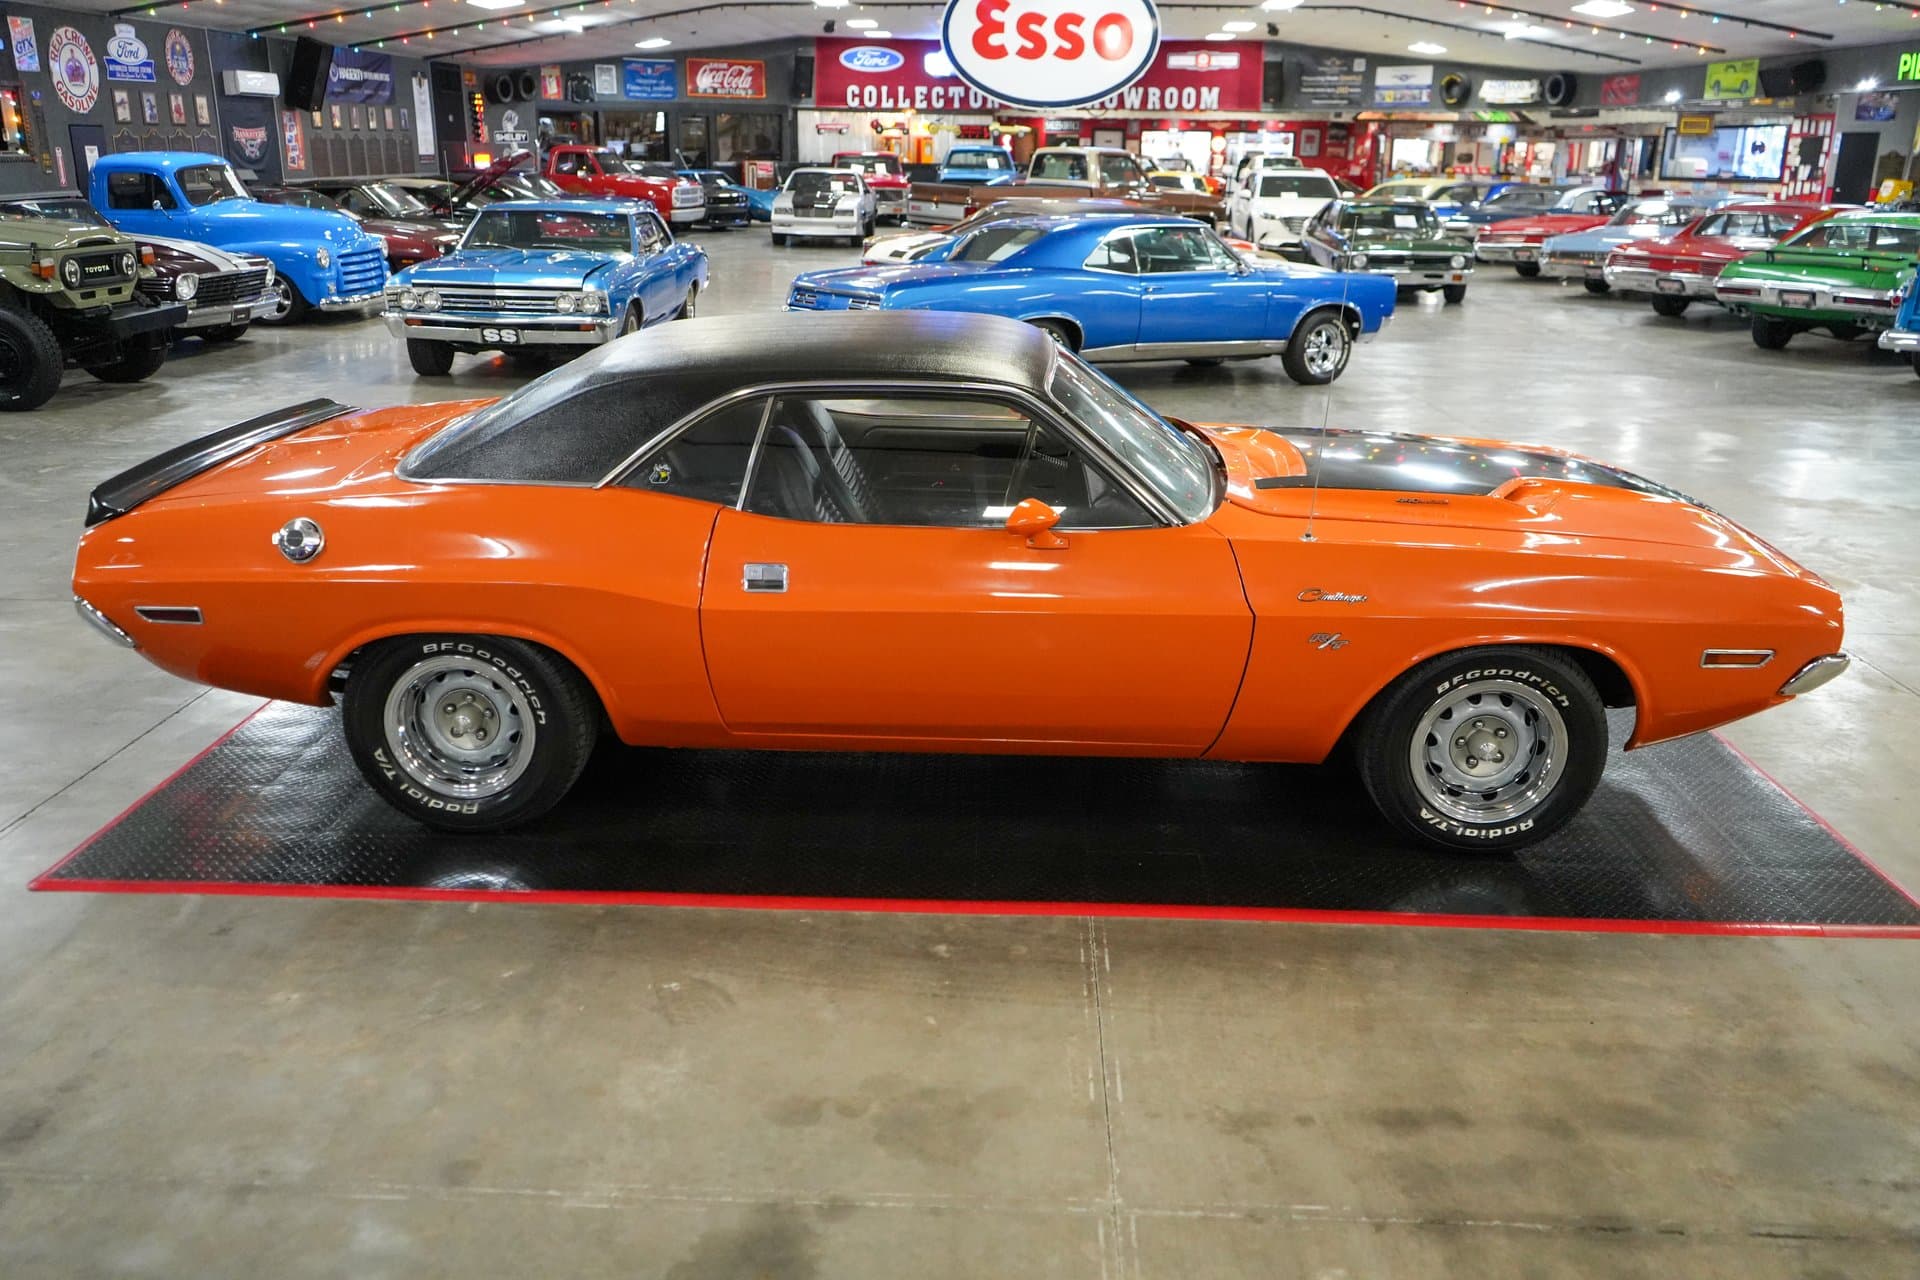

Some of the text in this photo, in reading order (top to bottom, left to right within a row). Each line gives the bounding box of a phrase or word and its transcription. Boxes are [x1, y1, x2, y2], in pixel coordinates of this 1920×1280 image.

[15, 37, 34, 54] GTX
[50, 34, 63, 63] RED
[64, 29, 96, 65] CROWN
[116, 41, 140, 59] Ford
[853, 50, 891, 67] Ford
[696, 64, 754, 89] Coca-Cola
[56, 81, 98, 112] GASOLINE
[1086, 86, 1221, 110] OWROOM
[495, 132, 528, 142] SHELBY
[84, 264, 110, 273] TOYOTA
[483, 328, 518, 342] SS
[1436, 668, 1570, 707] BFGoodrich
[373, 747, 479, 815] Radial T/A
[1420, 807, 1535, 839] Radial T/A
